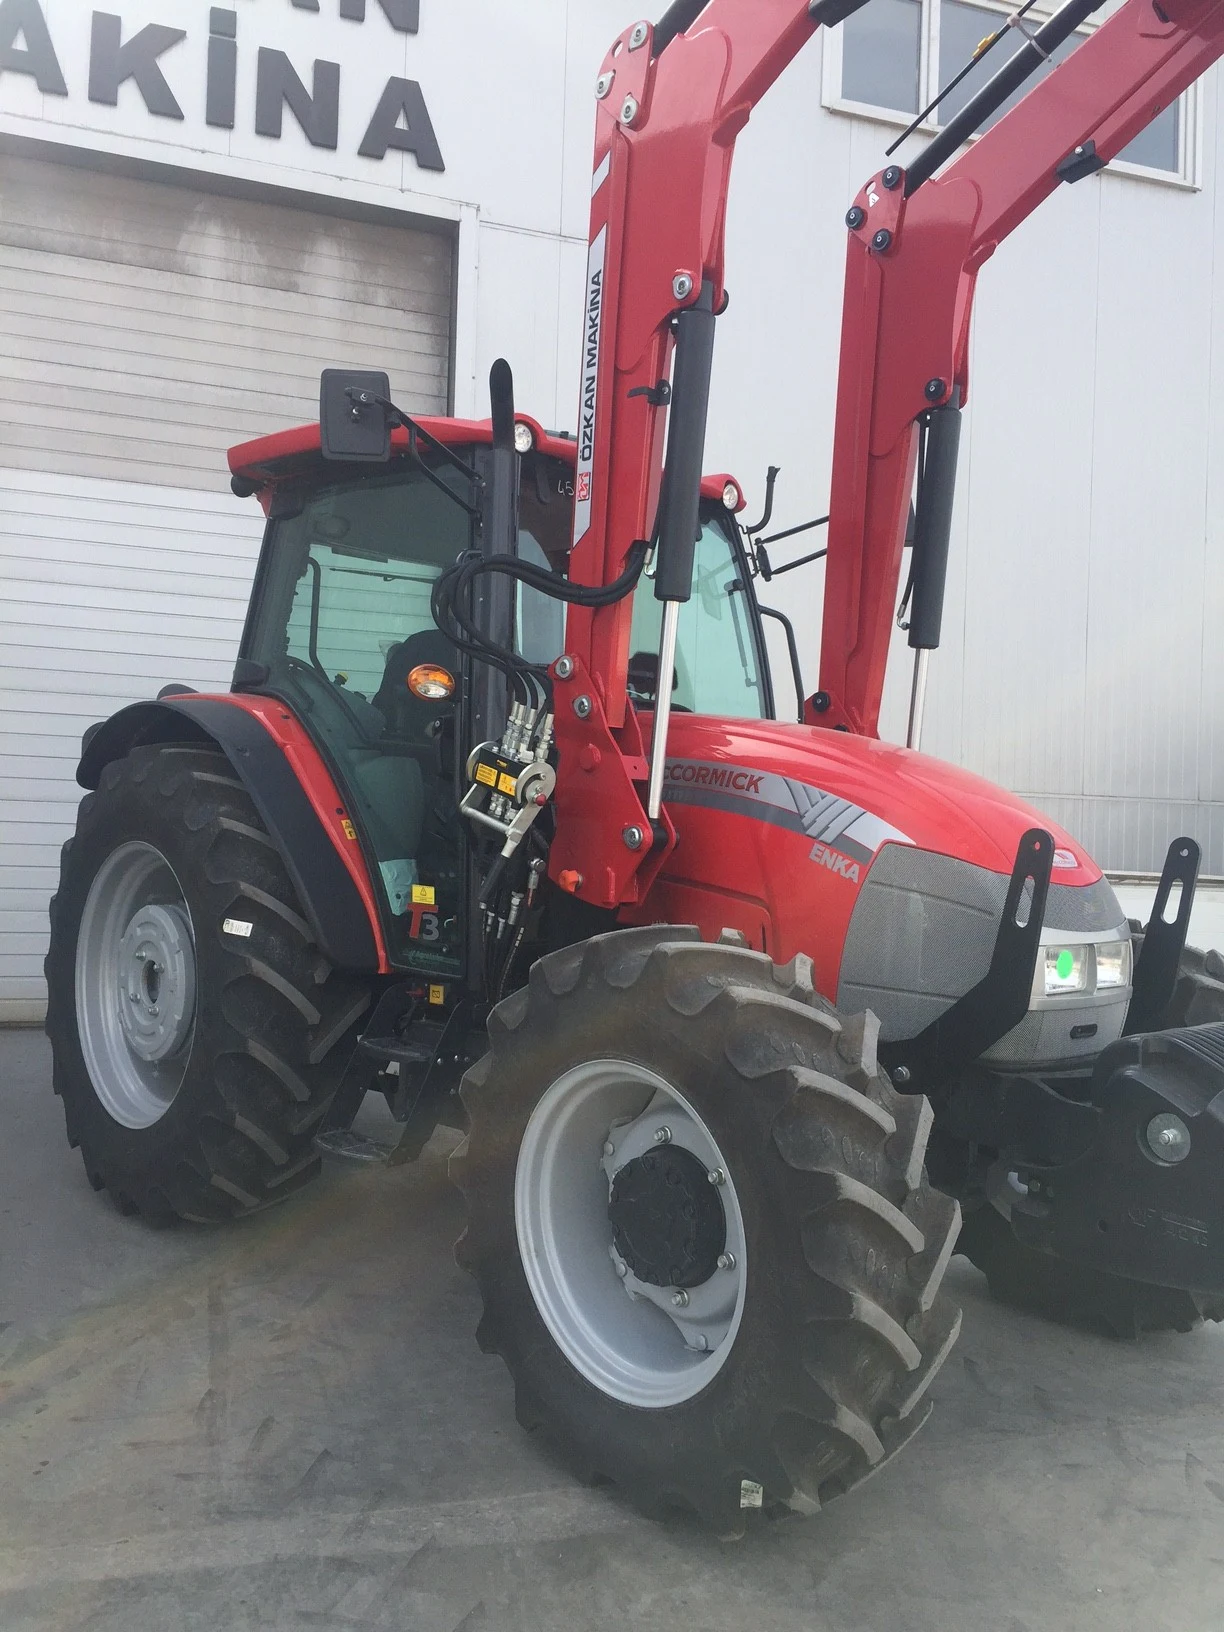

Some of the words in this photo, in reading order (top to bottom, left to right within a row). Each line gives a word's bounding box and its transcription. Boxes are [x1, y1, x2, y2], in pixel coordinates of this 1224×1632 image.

[586, 269, 602, 369] MAKİNA
[580, 375, 596, 462] ÖZKAN
[808, 843, 860, 883] ENKA
[406, 903, 440, 941] T3
